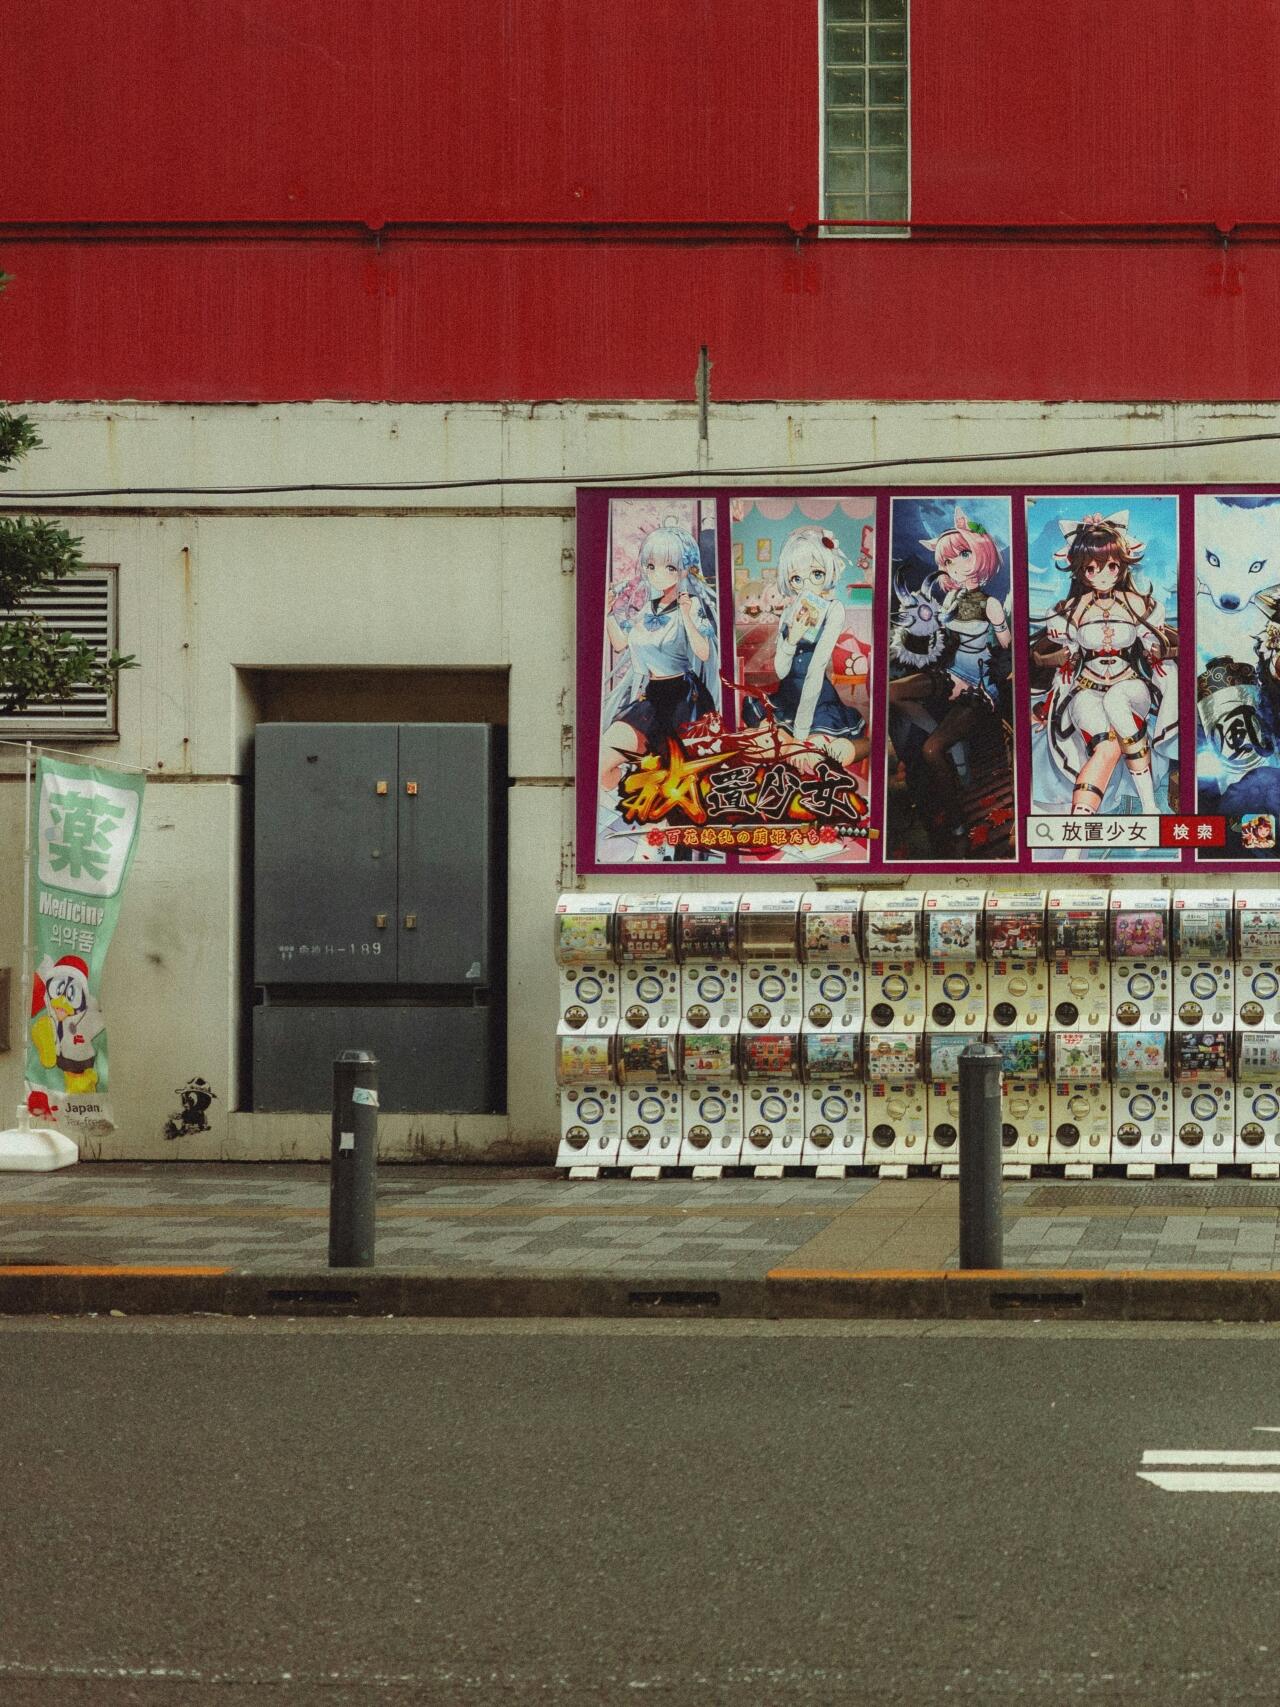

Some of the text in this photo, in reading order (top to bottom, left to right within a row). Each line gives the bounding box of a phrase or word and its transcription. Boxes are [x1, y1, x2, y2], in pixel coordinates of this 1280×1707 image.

[622, 738, 859, 824] 放置少女
[49, 790, 126, 881] 薬
[665, 828, 821, 845] 百花繚乱の萌姫たち
[1062, 821, 1148, 842] 放置少女
[1172, 824, 1213, 840] 検索
[50, 924, 96, 953] 의약품
